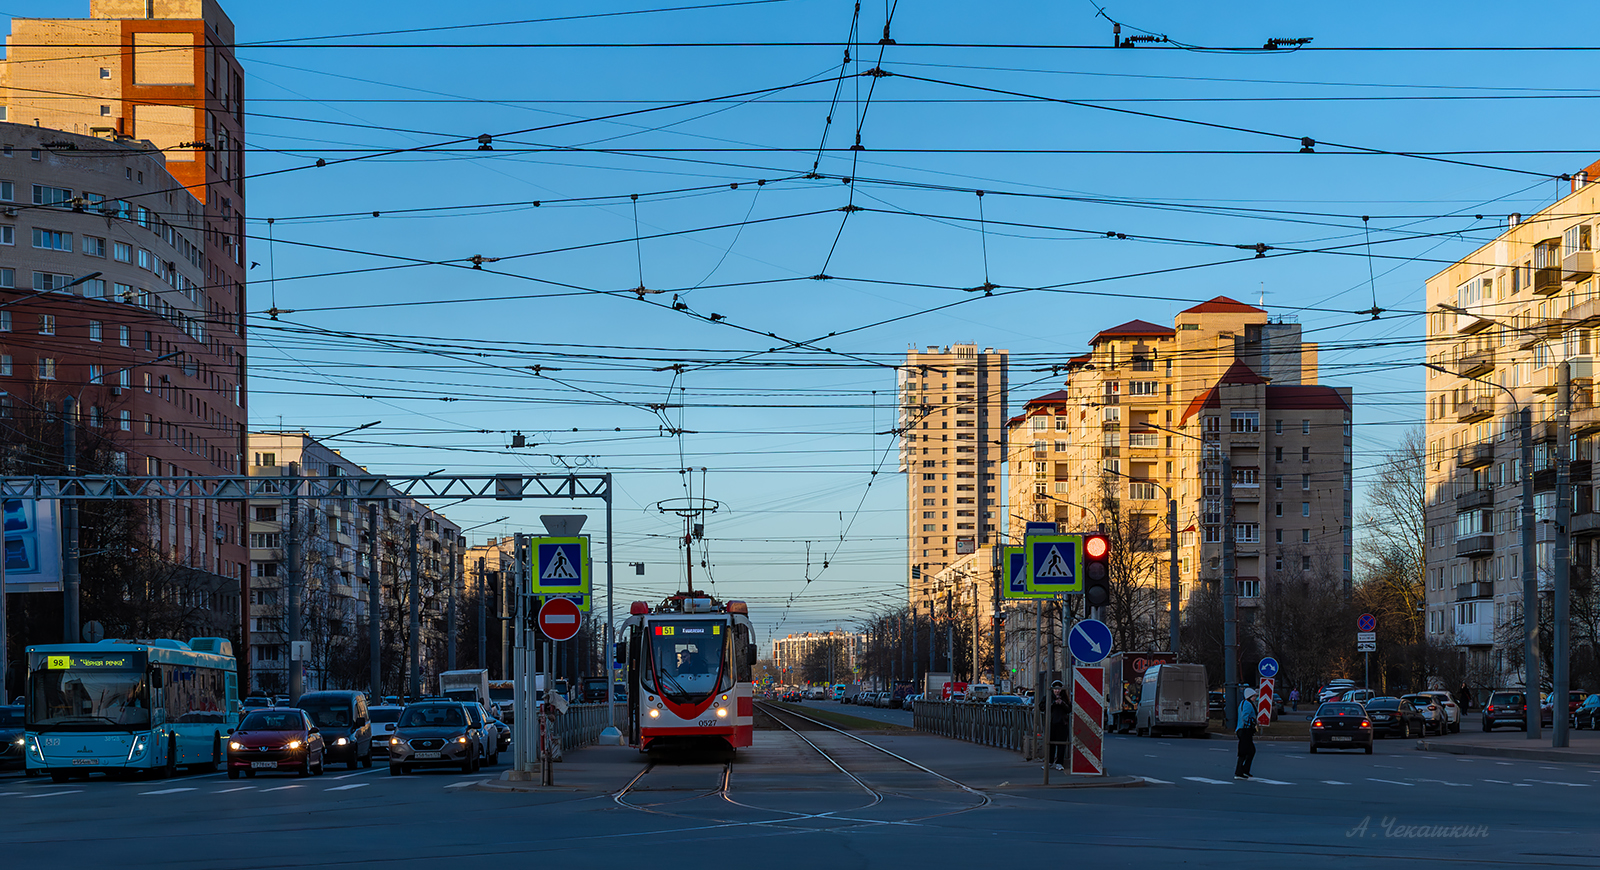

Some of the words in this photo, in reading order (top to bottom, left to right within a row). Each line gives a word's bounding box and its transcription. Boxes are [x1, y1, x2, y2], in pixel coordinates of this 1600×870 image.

[664, 627, 672, 635] 51
[53, 659, 64, 667] 98
[698, 719, 717, 727] 0527
